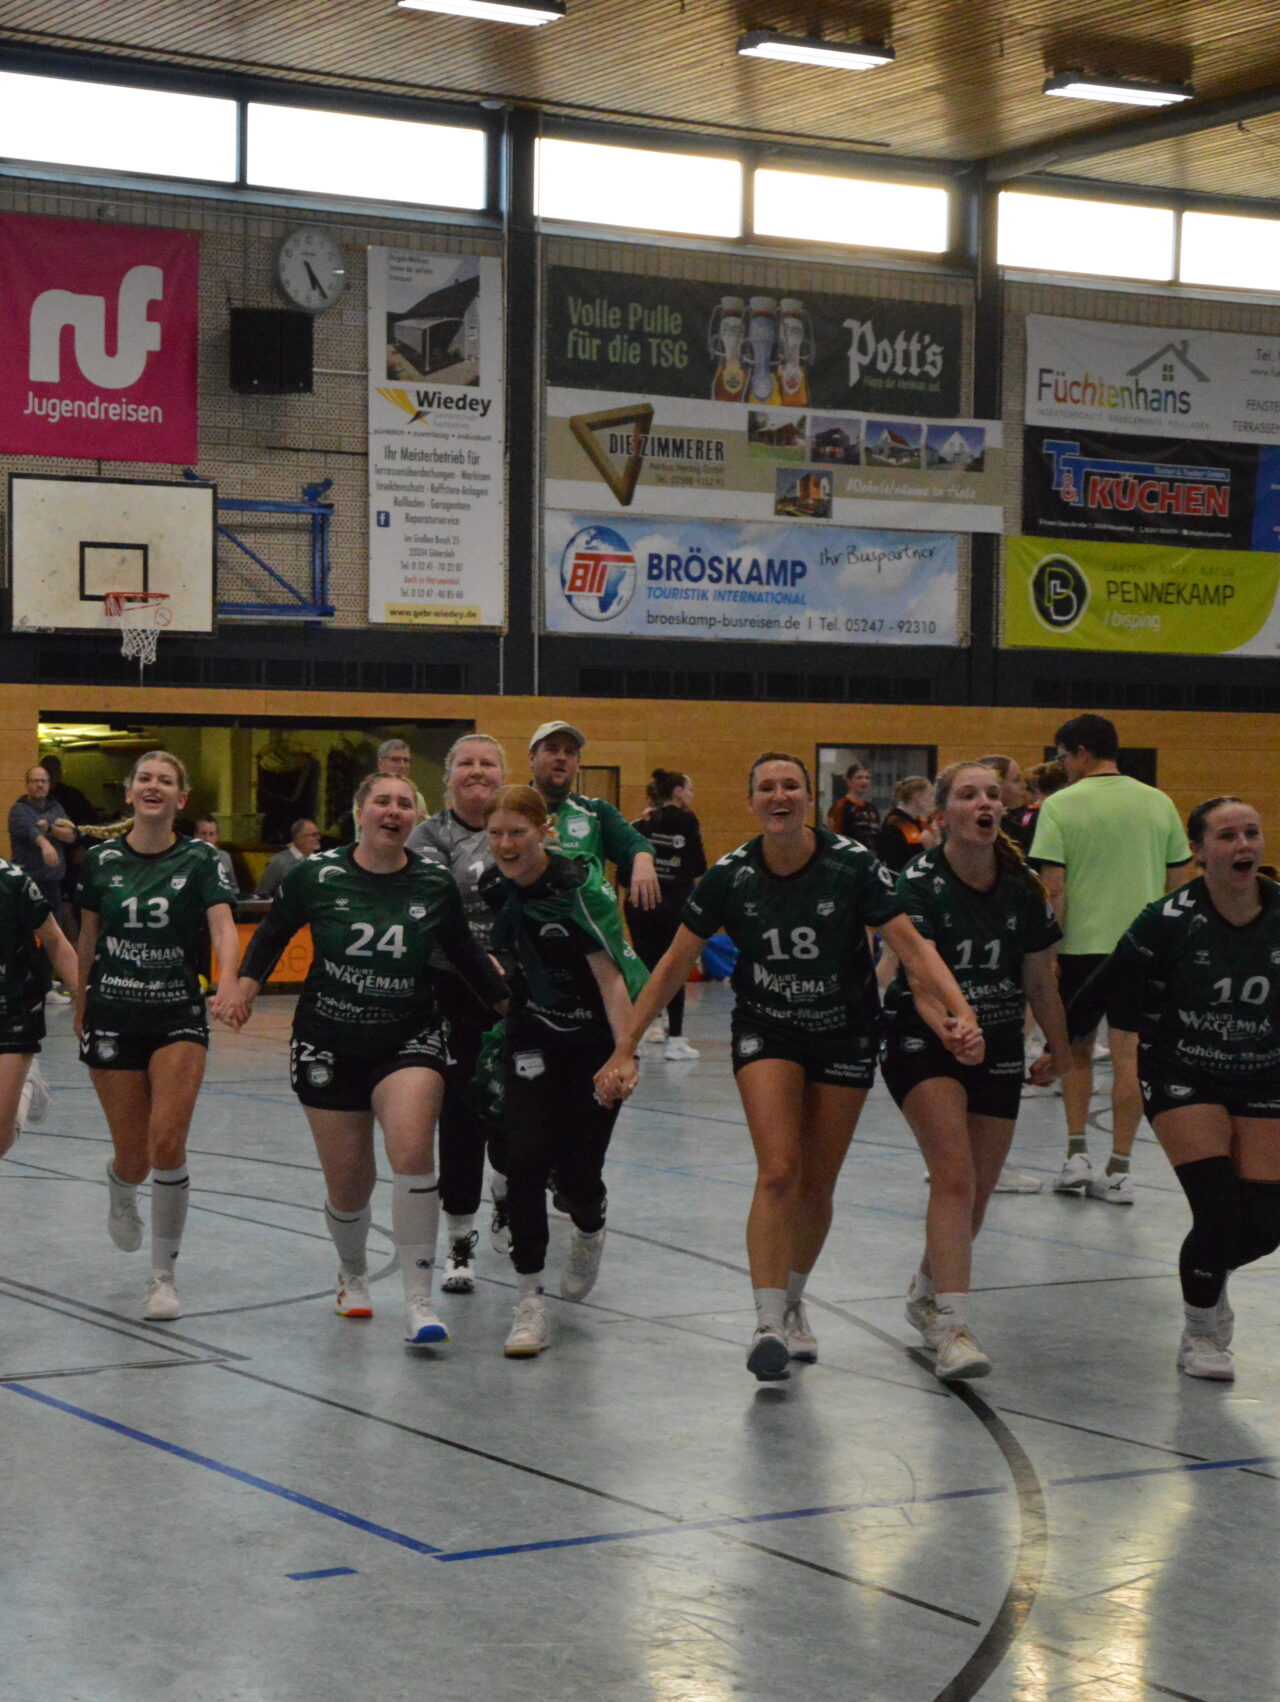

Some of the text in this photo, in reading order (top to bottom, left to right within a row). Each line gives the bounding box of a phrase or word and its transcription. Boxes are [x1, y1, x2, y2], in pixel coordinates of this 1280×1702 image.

[29, 265, 163, 389] ruf
[568, 296, 682, 335] Volle Pulle
[567, 328, 689, 369] für die TSG
[842, 318, 944, 388] Pott's
[416, 390, 492, 417] Wiedey
[1038, 367, 1192, 415] Füchtenhans
[23, 391, 163, 424] Jugendreisen
[384, 445, 481, 465] Ihr Meisterbetrieb für
[609, 433, 725, 461] DIE ZIMMERER
[1088, 473, 1231, 517] KÜCHEN
[567, 552, 635, 594] BTI
[647, 547, 807, 587] BRÖSKAMP
[820, 544, 937, 573] Ihr Buspartner
[647, 586, 807, 606] TOURISTIK INTERNATIONAL
[1106, 580, 1235, 606] PENNEKAMP
[646, 610, 936, 634] broeskamp-busreisen.de Tel. 05247 92310
[121, 896, 170, 928] 13
[106, 936, 184, 967] WAGEMANN
[345, 922, 408, 959] 24
[762, 927, 820, 960] 18
[953, 939, 1001, 970] 11
[1210, 975, 1270, 1006] 10
